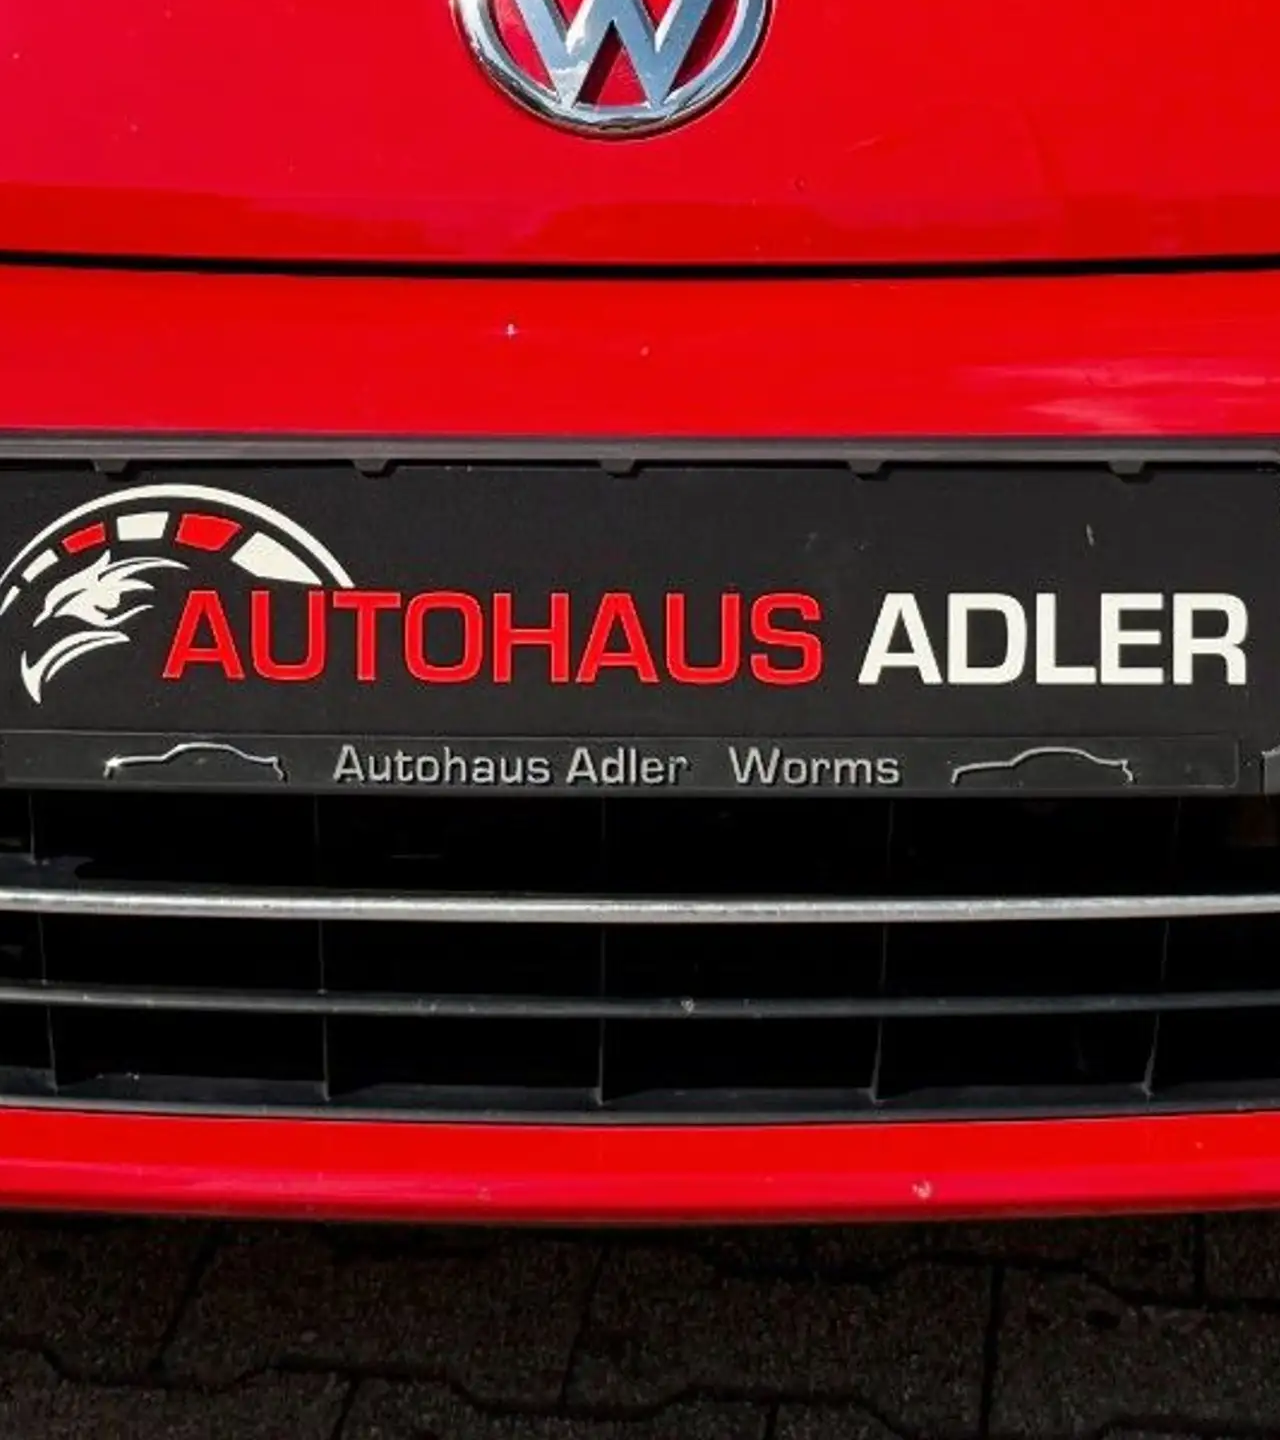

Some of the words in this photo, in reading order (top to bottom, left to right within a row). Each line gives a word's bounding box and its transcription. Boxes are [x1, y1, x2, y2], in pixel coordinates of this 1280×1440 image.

[162, 590, 823, 684] AUTOHAUS
[858, 592, 1249, 685] ADLER
[332, 745, 557, 785] Autohaus
[565, 745, 688, 785] Adler
[728, 746, 901, 785] Worms
